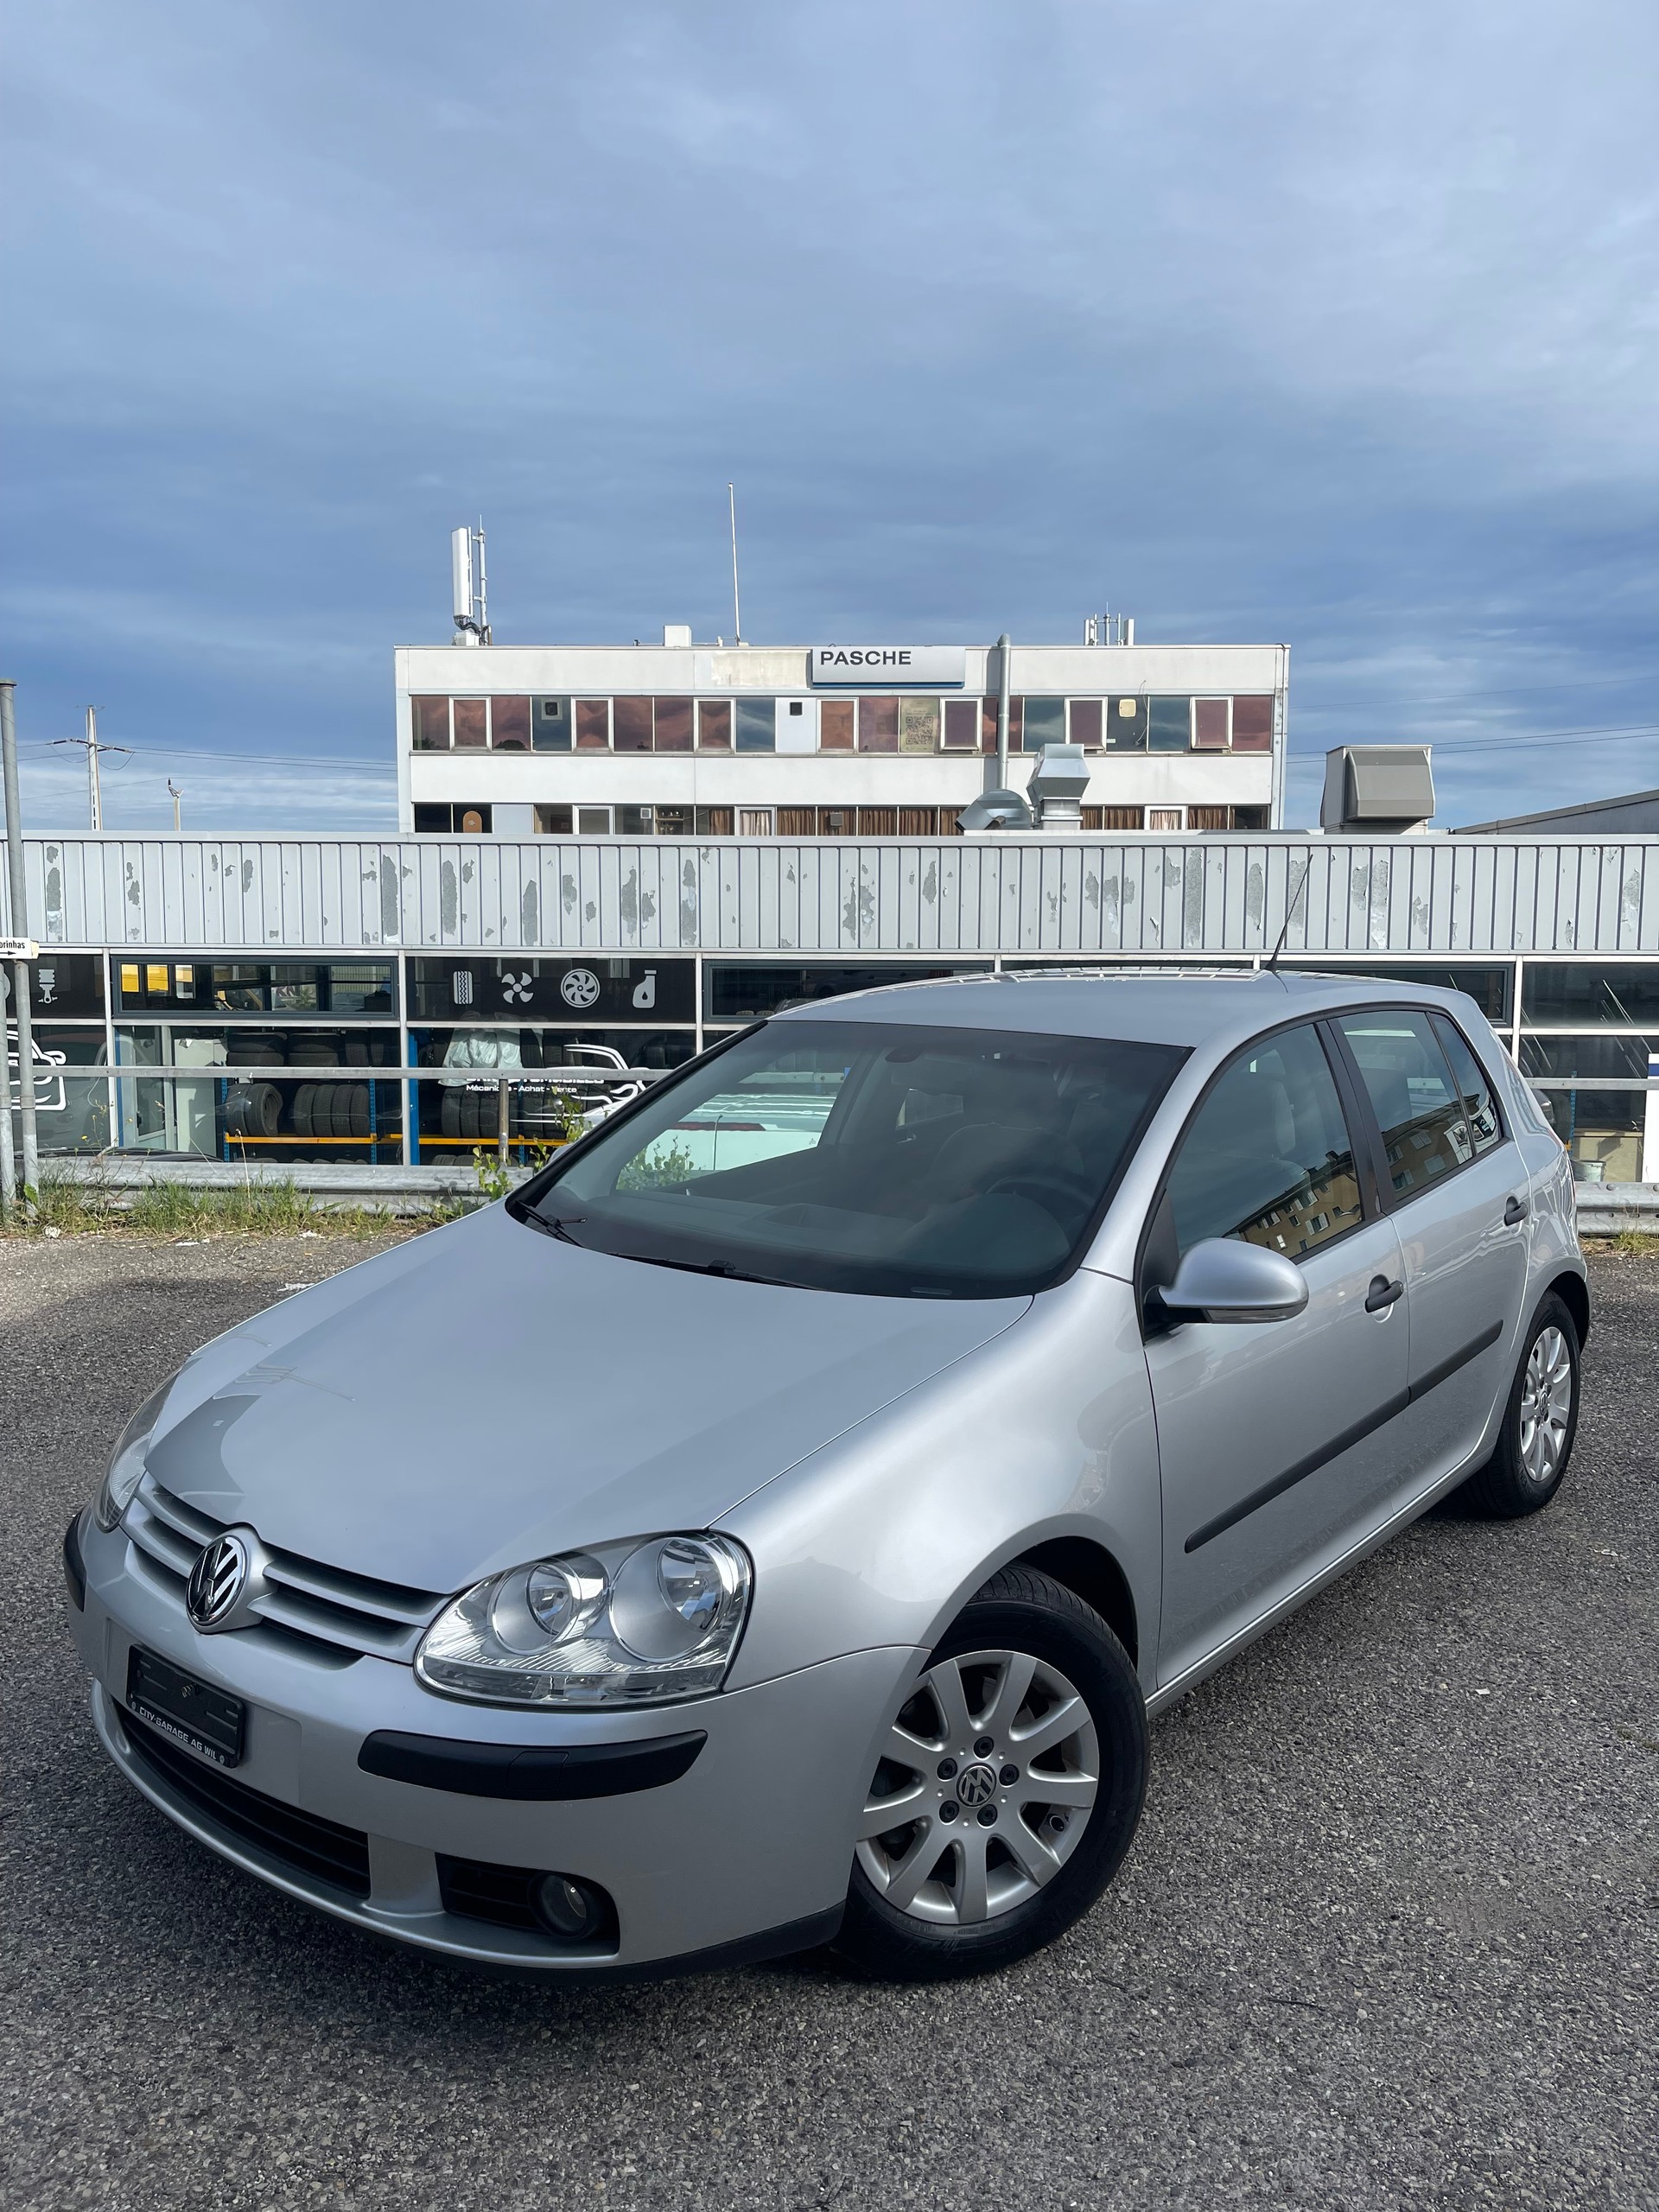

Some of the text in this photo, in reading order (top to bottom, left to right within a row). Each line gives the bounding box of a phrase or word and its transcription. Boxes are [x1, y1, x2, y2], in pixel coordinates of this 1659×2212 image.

[820, 651, 912, 665] PASCHE
[191, 1738, 203, 1751] AG
[204, 1745, 217, 1759] WIL
